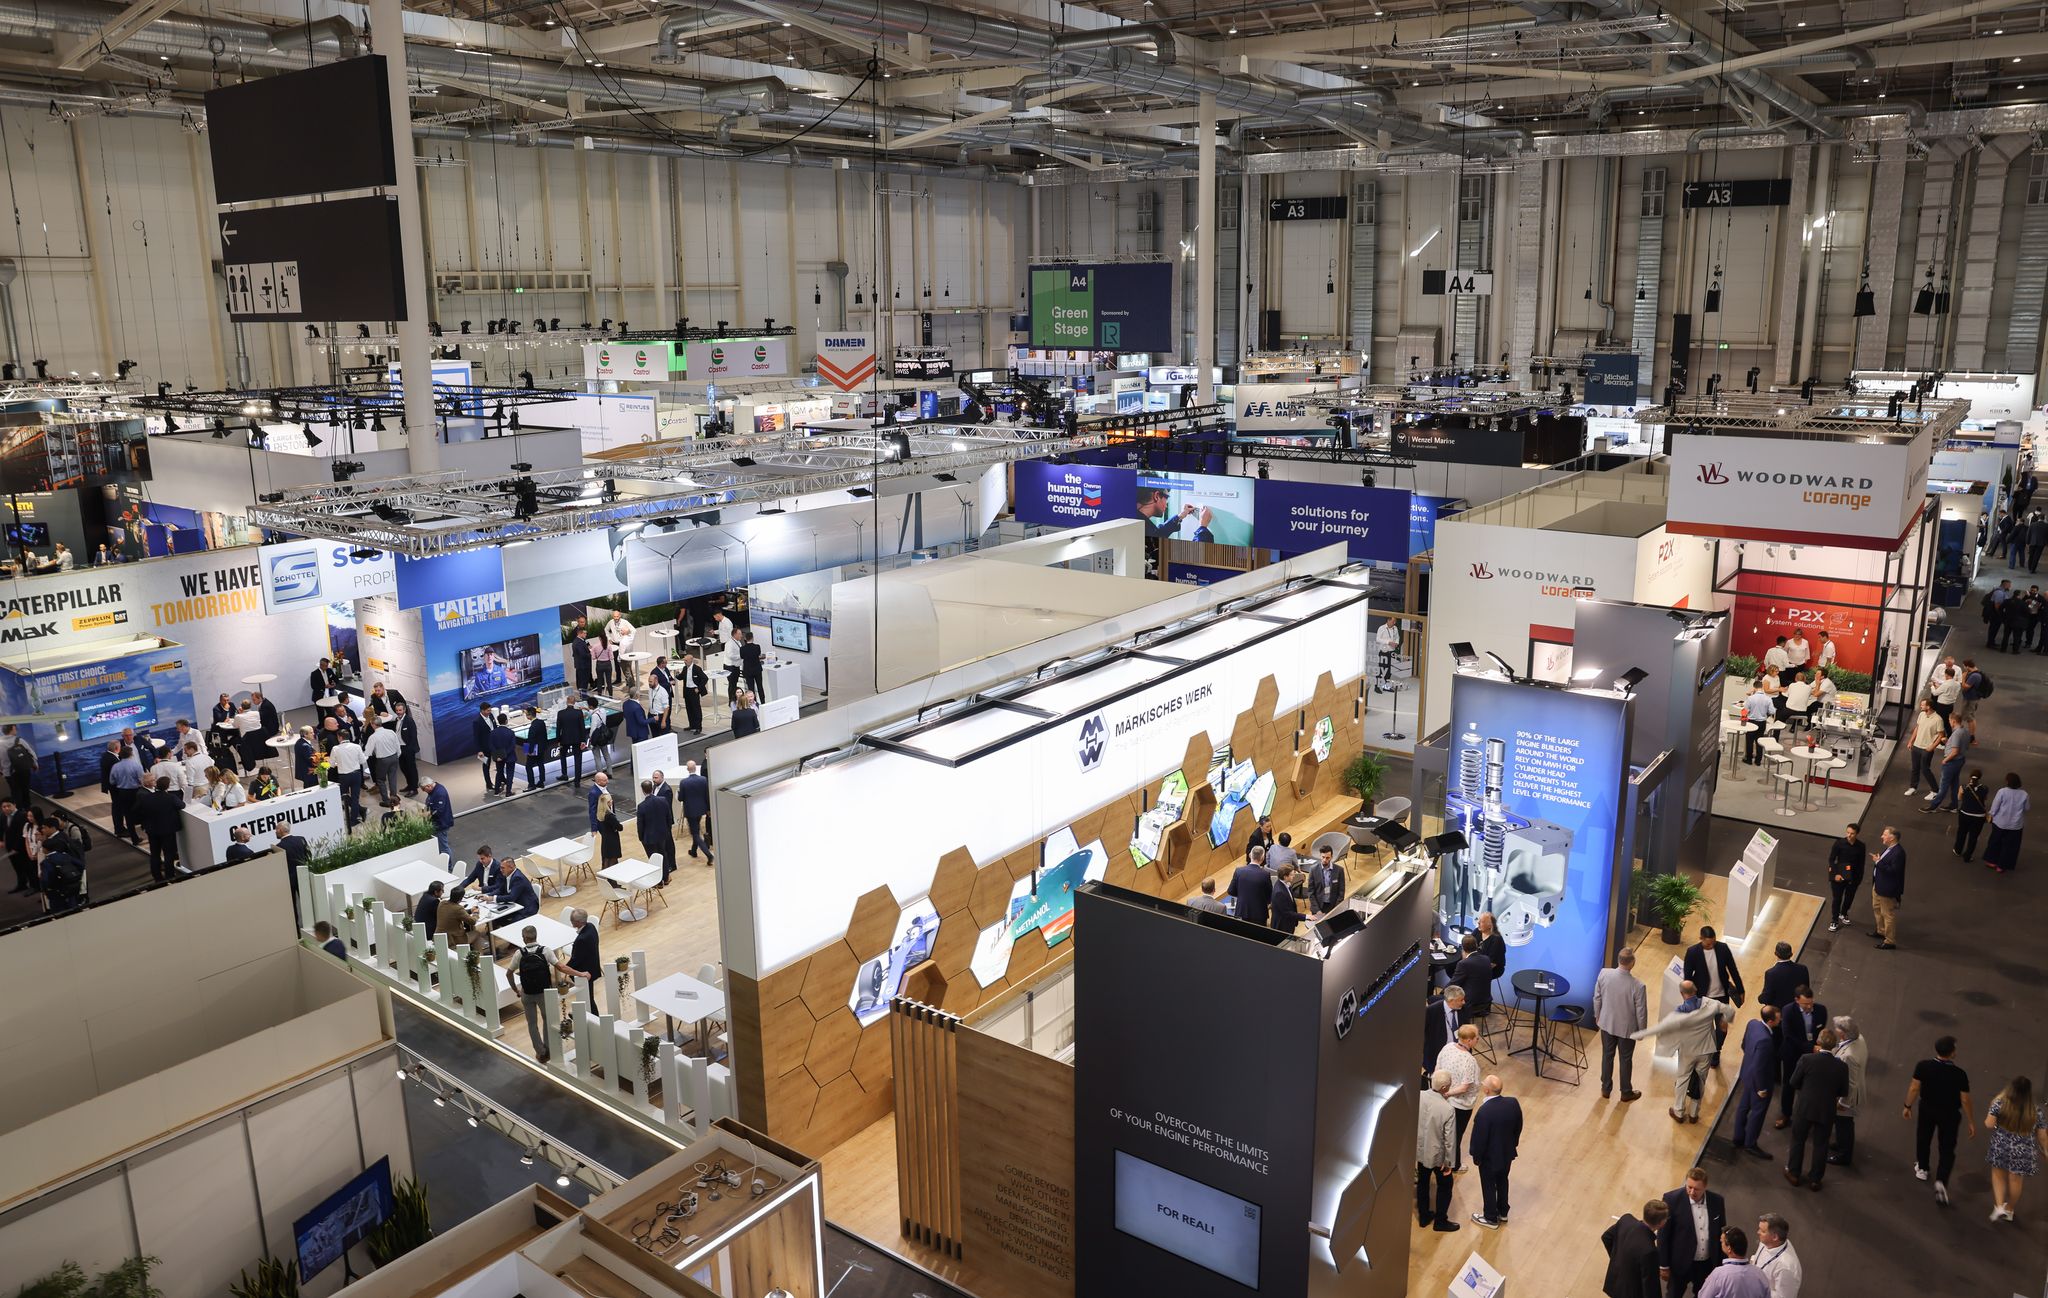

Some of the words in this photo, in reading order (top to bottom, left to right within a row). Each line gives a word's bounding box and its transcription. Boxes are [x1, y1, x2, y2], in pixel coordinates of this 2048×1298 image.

[1707, 190, 1730, 204] A3
[1288, 205, 1304, 218] A3
[285, 266, 296, 277] WC
[1072, 276, 1086, 287] A4
[1448, 276, 1476, 293] A4
[1052, 306, 1088, 318] Green
[1054, 322, 1088, 338] Stage
[825, 338, 866, 347] DAMEN
[633, 368, 650, 376] Castrol
[1604, 379, 1634, 387] Bearings
[1128, 452, 1138, 461] the
[1064, 473, 1082, 484] the
[1738, 471, 1873, 489] WOODWARD
[1048, 482, 1082, 494] human
[1048, 494, 1082, 506] energy
[1804, 491, 1871, 510] L'orange
[1052, 505, 1098, 519] company
[1291, 505, 1346, 520] solutions
[1351, 509, 1369, 521] for
[1290, 520, 1318, 531] your
[1321, 521, 1369, 538] journey
[1658, 537, 1675, 565] P2X
[181, 573, 209, 598] WE
[215, 565, 260, 593] HAVE
[274, 570, 316, 583] SCHOTTEL
[1498, 567, 1594, 586] WOODWARD
[0, 583, 122, 620] CATERPILLAR
[152, 589, 258, 627] TOMORROW
[78, 615, 111, 625] ZEPPELIN
[114, 611, 127, 623] CAT
[438, 616, 475, 631] NAVIGATING
[476, 612, 487, 622] THE
[1770, 618, 1792, 627] ystem
[1788, 608, 1825, 623] P2X
[36, 672, 57, 687] YOUR
[58, 669, 79, 682] FIRST
[79, 665, 106, 680] CHOICE
[37, 686, 51, 696] FOR
[100, 671, 128, 684] FUTURE.
[1115, 696, 1183, 737] MÄRKISCHES
[1185, 683, 1213, 705] WERK
[1516, 739, 1539, 749] ENGINE
[1541, 742, 1572, 754] BUILDERS
[1517, 731, 1532, 739] 90%
[1534, 733, 1542, 741] OF
[1544, 735, 1556, 743] THE
[1558, 737, 1580, 747] LARGE
[1515, 748, 1544, 758] AROUND
[1546, 752, 1558, 760] THE
[1559, 754, 1584, 764] WORLD
[1515, 756, 1529, 764] RELY
[1531, 758, 1541, 766] ON
[1543, 760, 1562, 769] MWH
[1563, 763, 1576, 772] FOR
[1515, 764, 1545, 774] CYLINDER
[1547, 769, 1566, 778] HEAD
[1514, 772, 1559, 786] COMPONENTS
[1561, 780, 1578, 789] THAT
[1513, 780, 1539, 791] DELIVER
[1540, 784, 1552, 793] THE
[1554, 787, 1582, 798] HIGHEST
[1513, 788, 1531, 797] LEVEL
[1542, 794, 1591, 809] PERFORMANCE
[1016, 902, 1050, 935] METHANOL
[1110, 1107, 1123, 1119] OF
[1124, 1112, 1152, 1132] YOUR
[1155, 1125, 1189, 1146] ENGINE
[1192, 1138, 1269, 1175] PERFORMANCE
[1155, 1112, 1212, 1141] OVERCOME
[1214, 1132, 1233, 1148] THE
[1236, 1140, 1269, 1161] LIMITS
[1004, 1164, 1032, 1182] GOING
[1035, 1176, 1070, 1198] BEYOND
[1023, 1196, 1058, 1216] POSSIBLE
[1038, 1190, 1069, 1210] OTHERS
[1157, 1204, 1179, 1222] FOR
[1182, 1214, 1215, 1235] REAL!
[1038, 1262, 1070, 1280] UNIQUE
